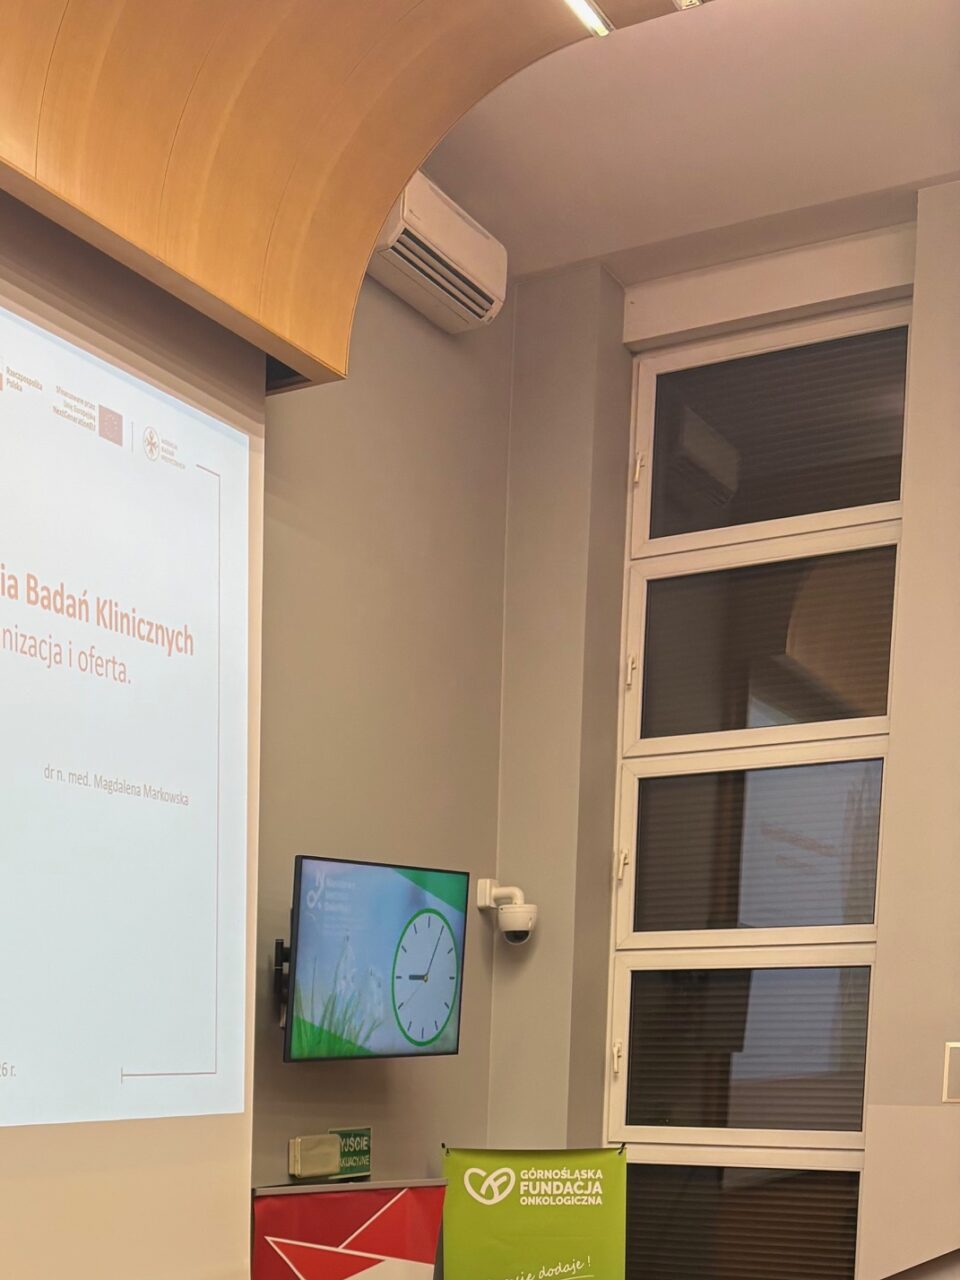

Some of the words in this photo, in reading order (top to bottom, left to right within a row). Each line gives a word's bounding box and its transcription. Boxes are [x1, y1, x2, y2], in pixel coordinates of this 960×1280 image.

[26, 573, 90, 623] Badań
[96, 596, 195, 656] Klinicznych
[68, 641, 73, 668] i
[78, 645, 132, 684] oferta.
[44, 764, 55, 780] dr
[57, 769, 66, 782] n.
[69, 771, 91, 788] med.
[94, 774, 141, 797] Magdalena
[143, 784, 190, 806] Markowska
[10, 1066, 17, 1078] r.
[520, 1167, 603, 1181] GÓRNOŚLĄSKA
[520, 1181, 603, 1195] FUNDACJA
[520, 1196, 603, 1206] ONKOLOGICZNA
[538, 1259, 584, 1279] dodaje
